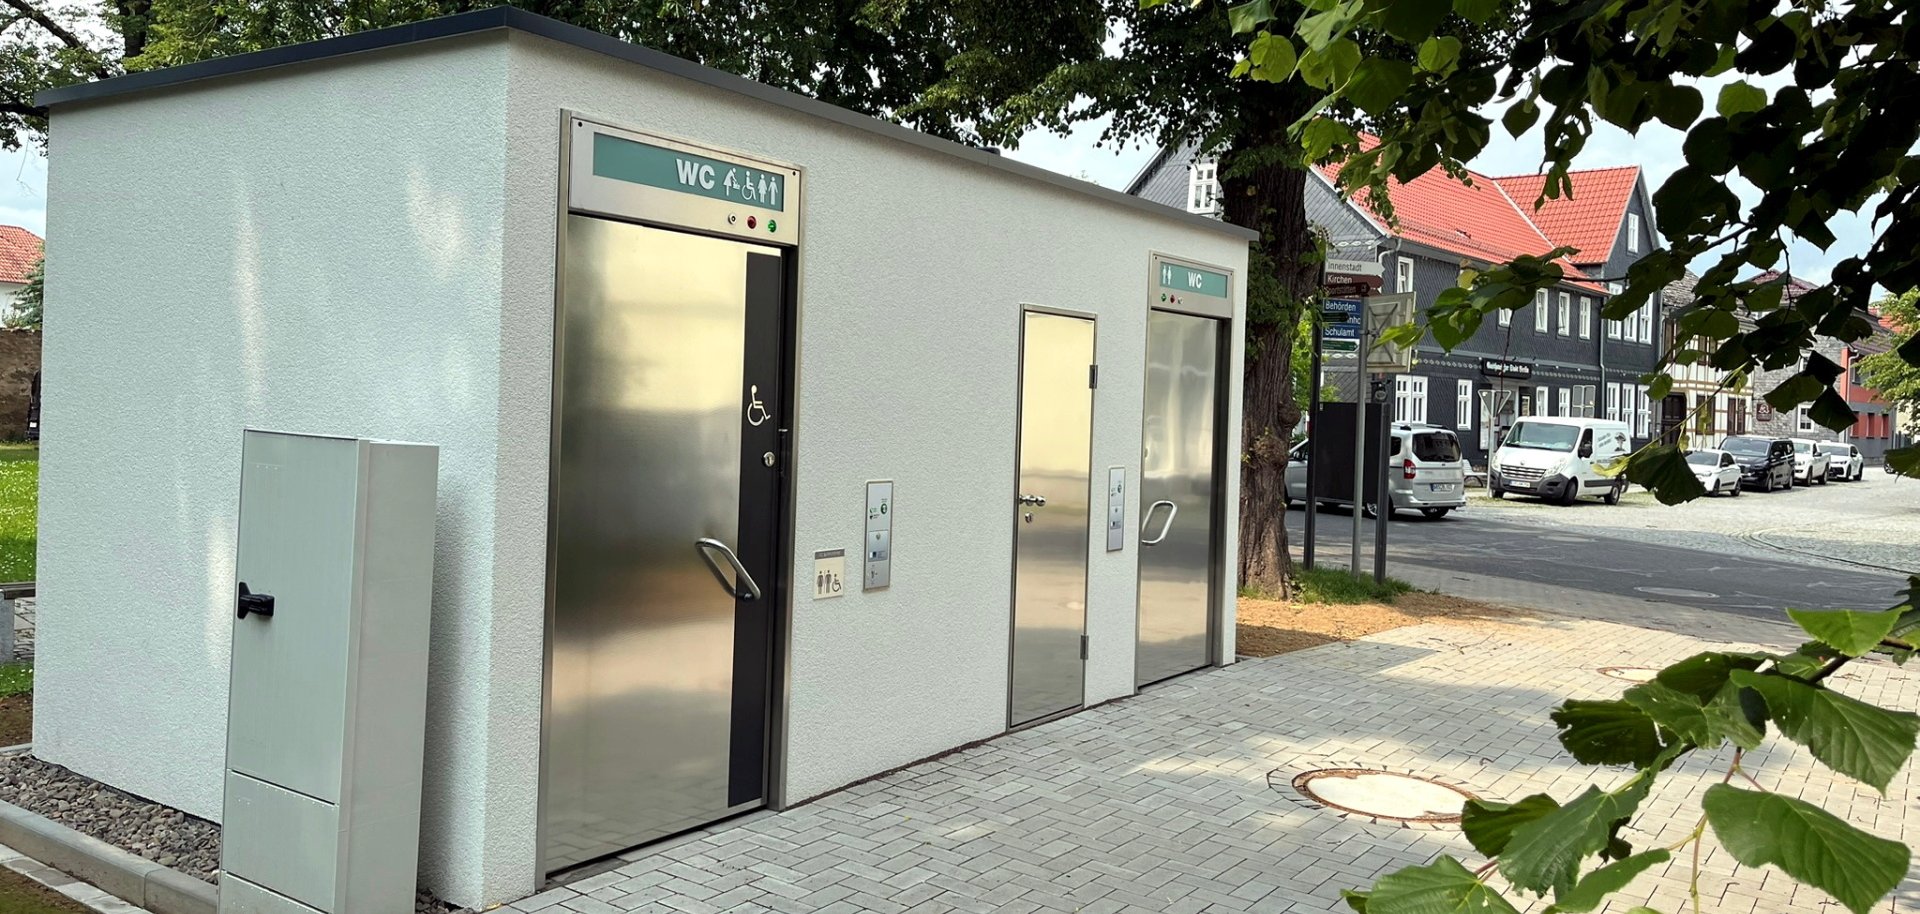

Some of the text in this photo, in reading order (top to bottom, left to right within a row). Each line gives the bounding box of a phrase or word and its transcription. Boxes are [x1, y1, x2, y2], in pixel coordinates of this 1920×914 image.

[676, 158, 715, 190] WC
[1328, 261, 1362, 272] Innenstadt
[1187, 271, 1202, 289] WC
[1327, 275, 1352, 284] Kirchen
[1325, 301, 1356, 312] Behörden
[1324, 327, 1355, 336] Schulamt
